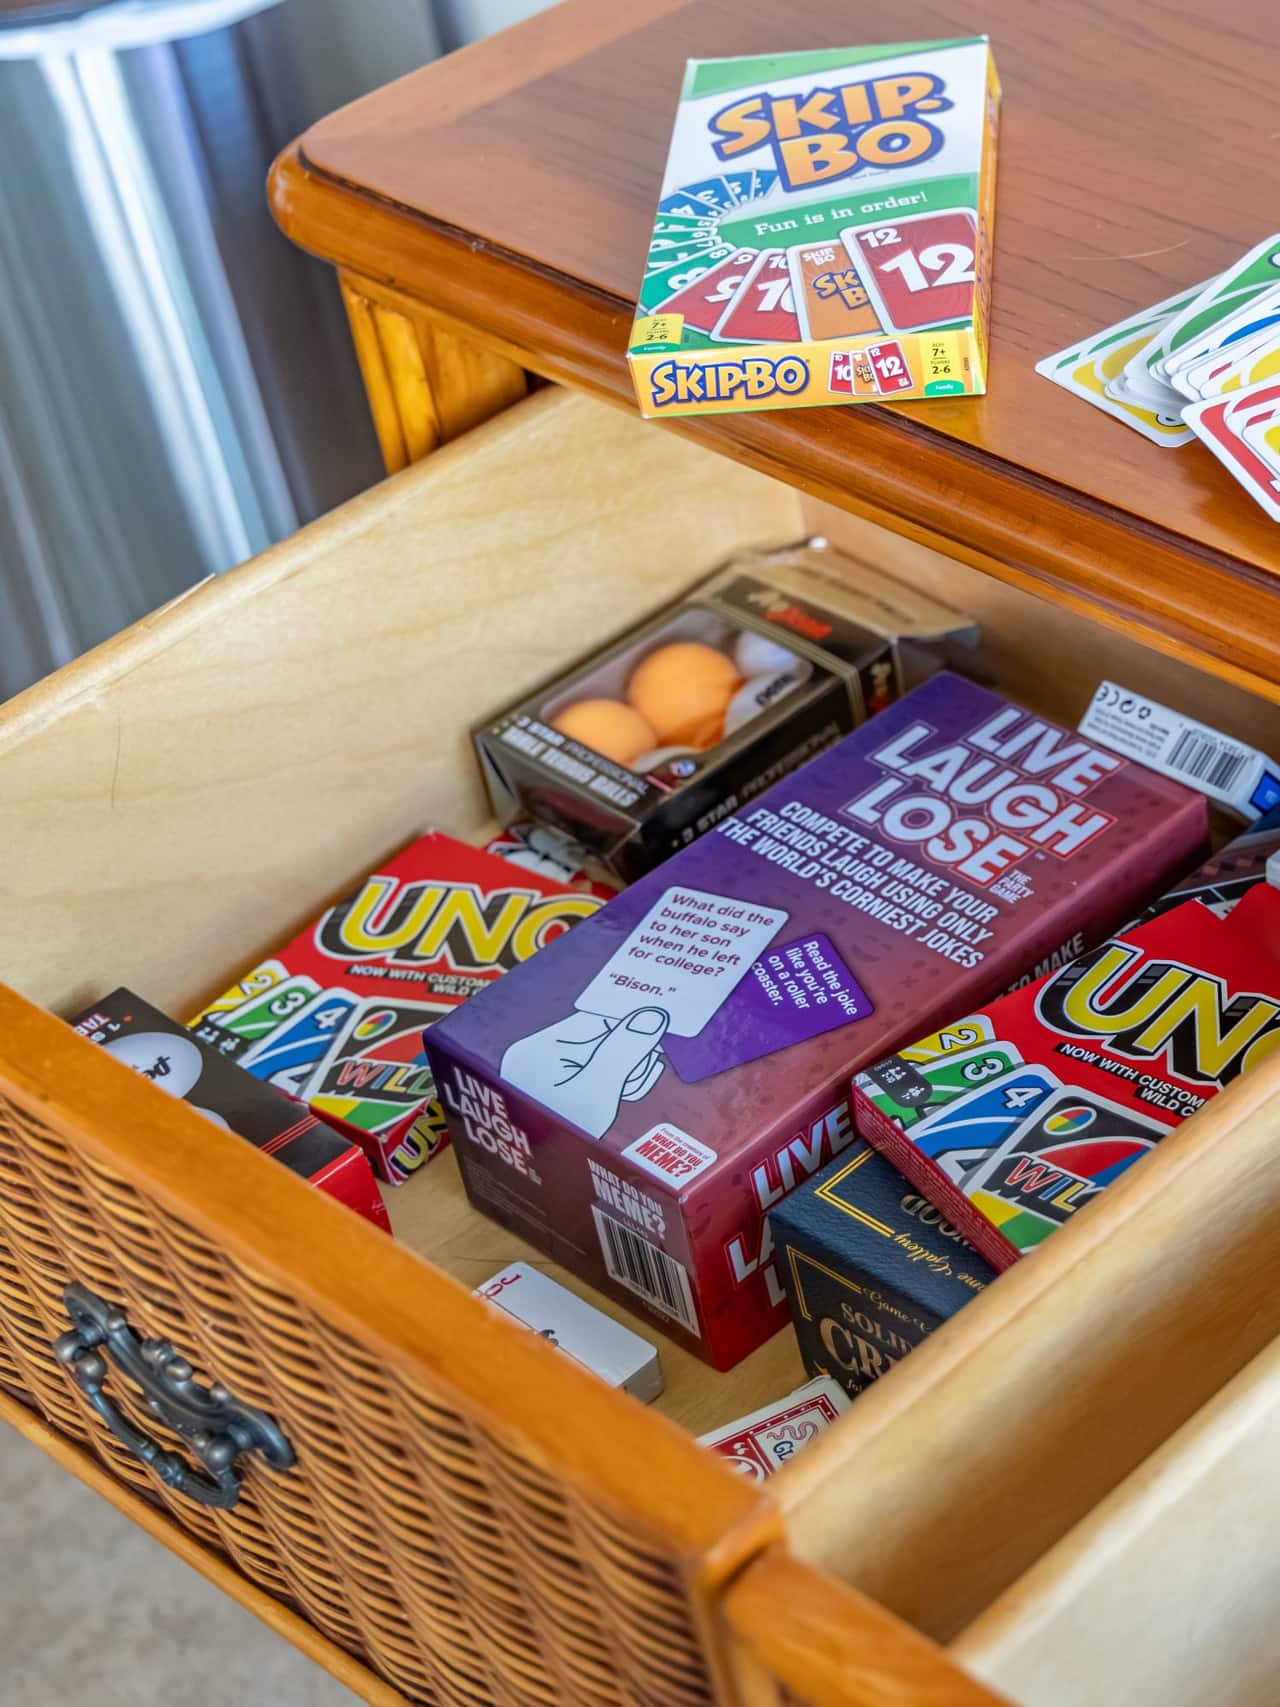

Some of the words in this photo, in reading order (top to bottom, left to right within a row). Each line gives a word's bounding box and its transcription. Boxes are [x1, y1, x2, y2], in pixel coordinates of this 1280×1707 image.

[777, 118, 943, 192] BO
[755, 220, 797, 238] Fun
[804, 211, 825, 226] is
[828, 205, 853, 220] in
[861, 192, 928, 215] order!
[860, 228, 902, 247] 12
[733, 254, 753, 265] 9
[879, 243, 975, 293] 12
[876, 355, 904, 379] 12
[932, 348, 947, 356] 7+
[932, 366, 951, 375] 2-6
[967, 706, 1123, 797] LIVE
[872, 723, 1115, 857] LAUGH
[844, 778, 1029, 885] LOSE
[747, 808, 828, 859] FRIENDS
[822, 850, 884, 893] LAUGH
[882, 883, 944, 919] USING
[936, 911, 993, 946] ONLY
[779, 801, 870, 853] COMPETE
[864, 846, 894, 868] TO
[887, 859, 949, 893] MAKE
[945, 888, 999, 925] YOUR
[1009, 869, 1033, 885] THE
[716, 816, 760, 847] THE
[751, 838, 838, 889] WORLD'S
[830, 882, 927, 936] CORNIEST
[917, 923, 984, 969] JOKES
[989, 884, 1022, 904] GAME
[1000, 877, 1035, 899] PARTY
[660, 907, 718, 929] buffalo
[720, 923, 751, 938] say
[672, 893, 715, 913] What
[717, 905, 745, 919] did
[747, 912, 774, 927] the
[639, 934, 684, 951] when
[687, 944, 709, 958] he
[711, 950, 741, 966] left
[649, 920, 668, 932] to
[670, 925, 699, 940] her
[701, 934, 732, 948] son
[628, 946, 655, 960] for
[655, 954, 726, 978] college?
[768, 955, 785, 971] on
[803, 941, 832, 971] Read
[1034, 931, 1085, 979] MAKE
[240, 969, 272, 995] 2
[350, 964, 387, 979] NOW
[388, 968, 426, 982] WITH
[427, 972, 491, 989] CUSTOM
[433, 983, 473, 996] WILD
[751, 962, 784, 1006] coaster.
[778, 971, 791, 980] a
[785, 947, 805, 969] like
[795, 969, 828, 1005] you're
[822, 970, 841, 990] the
[269, 991, 306, 1016] 3
[784, 980, 811, 1009] roller
[830, 988, 858, 1015] joke
[74, 1012, 111, 1037] TAB
[313, 1006, 348, 1029] 4
[939, 1028, 978, 1050] 2
[961, 1057, 1004, 1082] 3
[1060, 1043, 1101, 1063] NOW
[1100, 1057, 1139, 1081] WITH
[1138, 1074, 1206, 1109] CUSTOM
[454, 1066, 508, 1120] LIVE
[1003, 1087, 1043, 1110] 4
[1140, 1087, 1179, 1111] WILD
[443, 1082, 534, 1159] LAUGH
[386, 1100, 448, 1182] UN
[464, 1116, 529, 1176] LOSE
[651, 1132, 674, 1149] WHAT
[674, 1146, 687, 1157] DO
[685, 1152, 704, 1167] YOU
[753, 1100, 856, 1211] LIVE
[635, 1140, 694, 1178] MEME?
[587, 1157, 621, 1188] WHAT
[622, 1179, 638, 1196] DO
[640, 1189, 664, 1218] YOU
[1004, 1153, 1093, 1212] WIL
[593, 1174, 666, 1240] MEME?
[894, 1232, 953, 1278] Gallery
